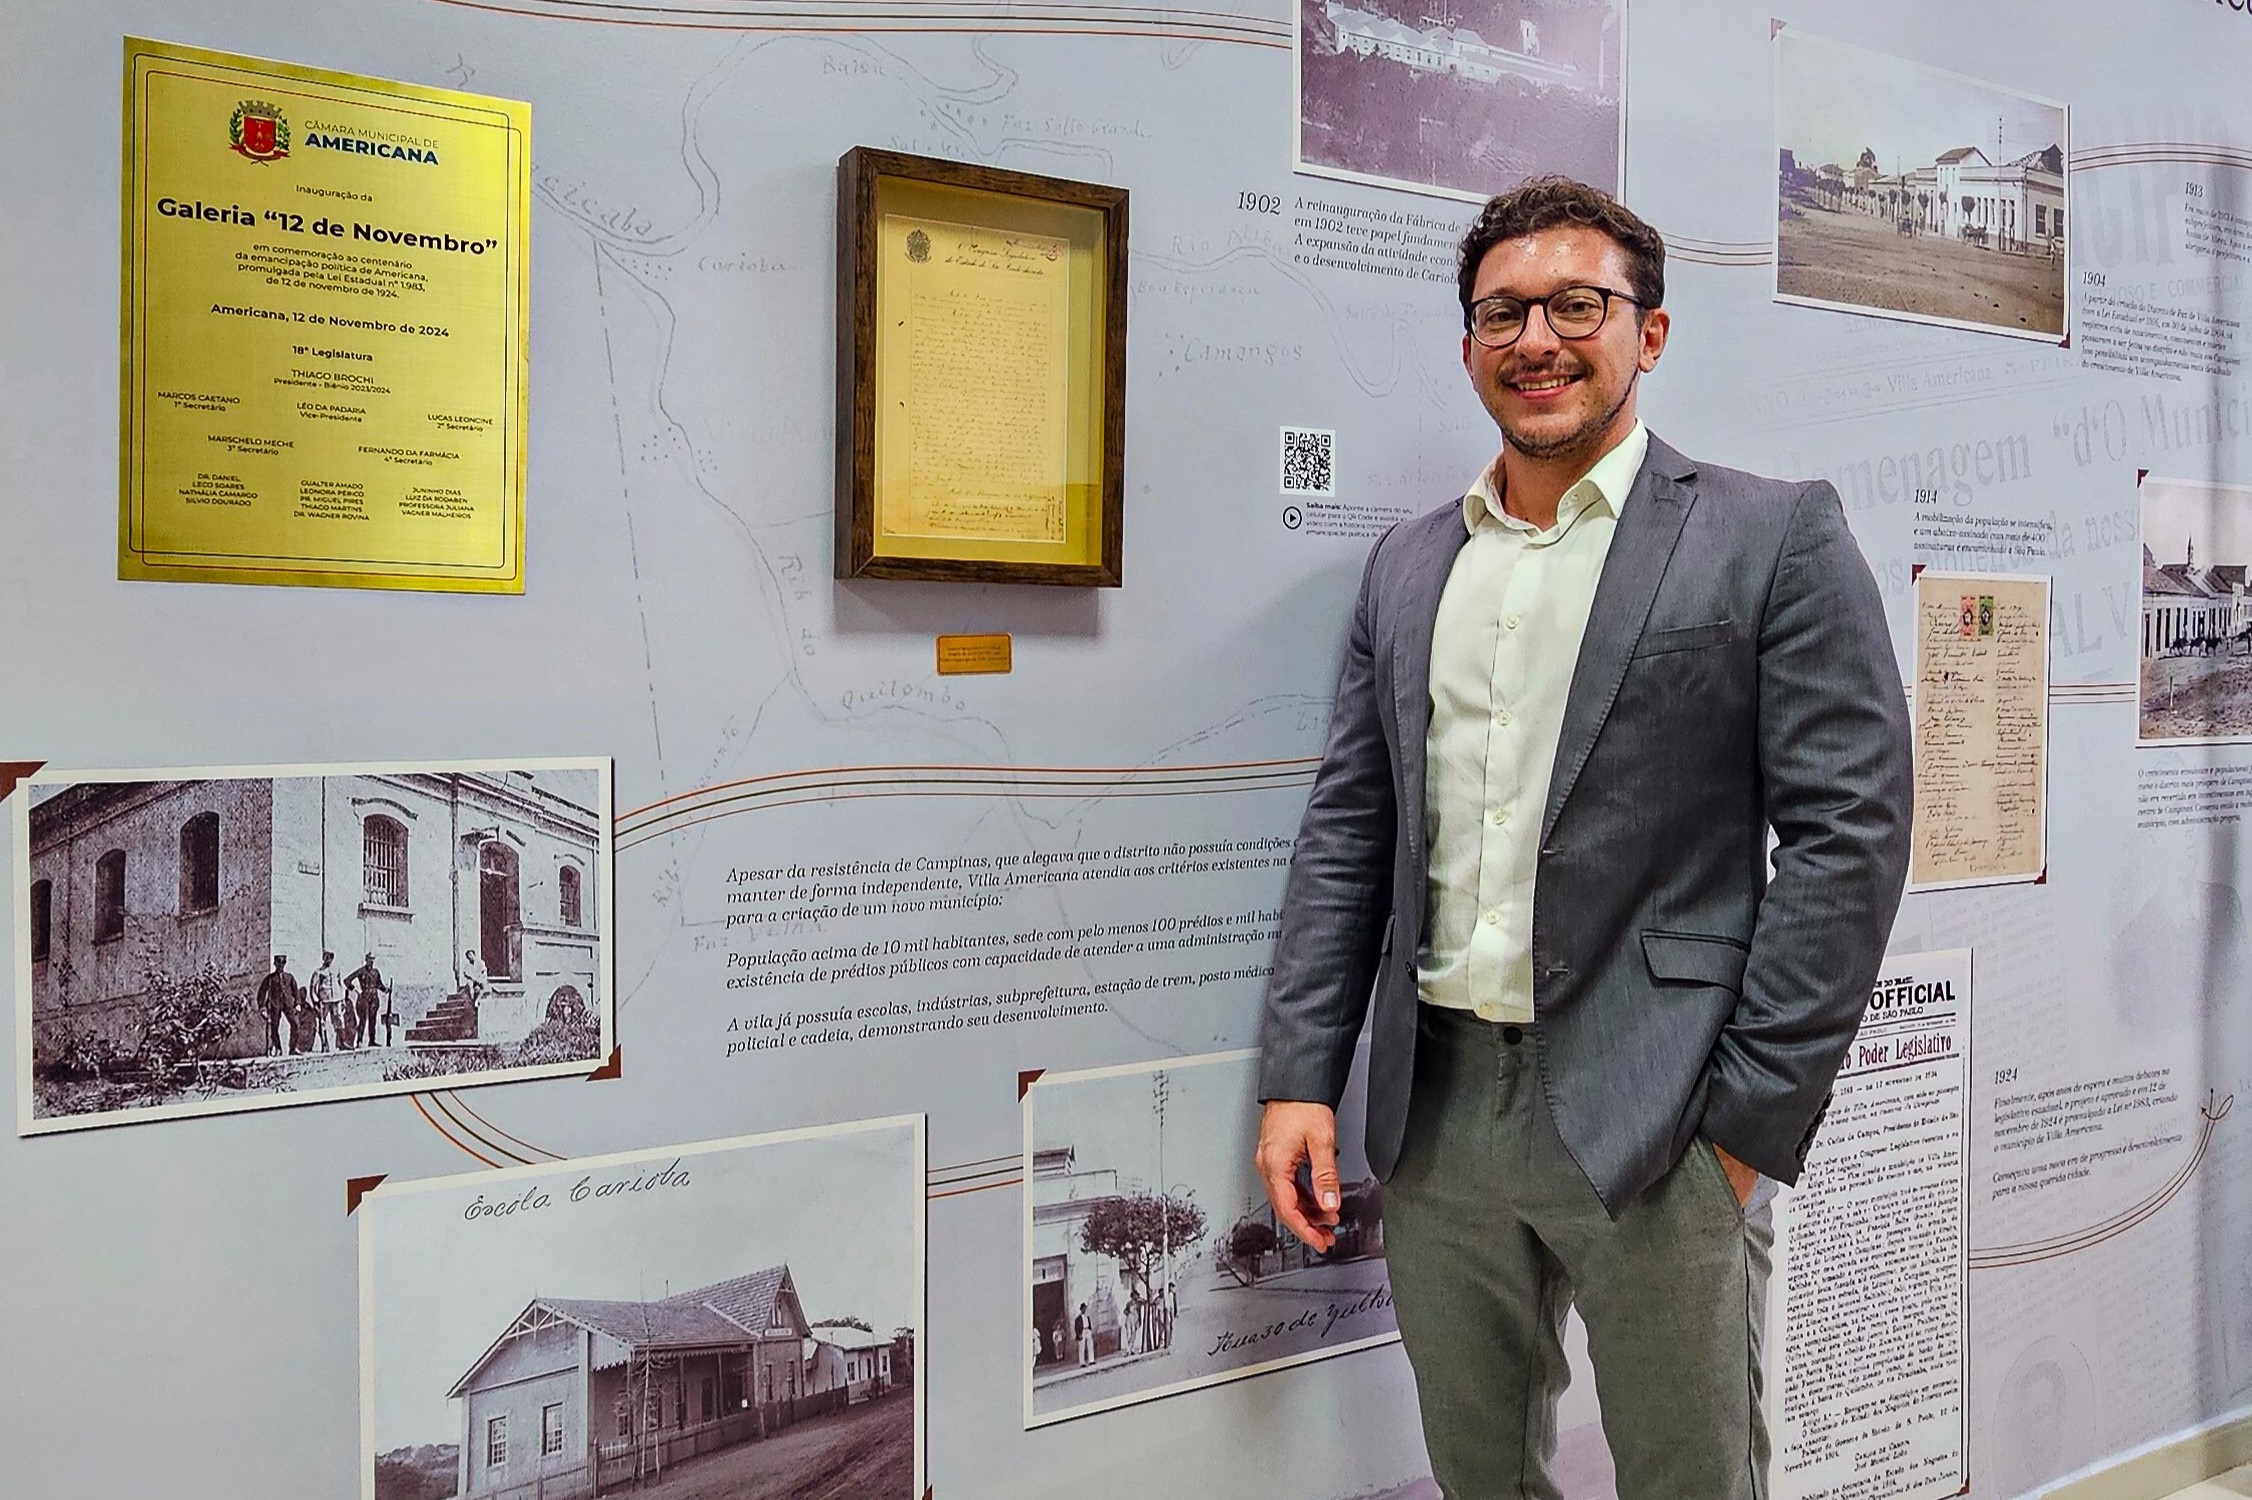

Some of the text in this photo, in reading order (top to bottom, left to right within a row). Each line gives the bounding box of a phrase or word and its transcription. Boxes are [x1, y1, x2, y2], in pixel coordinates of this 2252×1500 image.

[304, 120, 439, 149] CÂMARA MUNICIPAL DE
[304, 133, 438, 165] AMERICANA
[296, 184, 372, 202] Inauguração da
[1238, 191, 1280, 215] 1902
[157, 198, 255, 226] Galeria
[312, 217, 345, 237] de
[1294, 196, 1460, 232] A reinauguração da Fábrica de
[1294, 217, 1402, 245] em 1902 teve papel
[1294, 232, 1303, 245] A
[1306, 238, 1359, 253] expansão
[1360, 242, 1374, 256] da
[1377, 247, 1427, 262] atividade
[252, 244, 412, 269] em comemoração ao centenário
[1294, 252, 1456, 284] e o desenvolvimento de Cariob
[2083, 271, 2106, 288] 1904
[210, 303, 449, 337] Americana, 12 de Novembro de 2024
[311, 347, 373, 361] Legislatura
[291, 368, 374, 384] THIAGO BROCHI
[1914, 488, 1938, 504] 1914
[726, 868, 783, 886] Apesar
[786, 863, 805, 879] da
[810, 860, 890, 877] resistência
[894, 857, 911, 873] de
[916, 855, 991, 873] Campinas,
[995, 855, 1019, 870] que
[1022, 850, 1073, 867] alegava
[1077, 850, 1100, 865] que
[1103, 850, 1110, 860] o
[1113, 845, 1160, 859] distrito
[1163, 842, 1186, 856] não
[1187, 839, 1233, 858] possuía
[1236, 836, 1290, 852] condições
[727, 889, 785, 904] manter
[789, 884, 810, 901] de
[809, 882, 856, 903] forma
[862, 876, 962, 897] independente,
[968, 872, 999, 887] Villa
[1004, 870, 1078, 885] Americana
[1082, 864, 1130, 880] atendia
[1133, 866, 1154, 877] aos
[1157, 859, 1209, 875] critérios
[1211, 858, 1270, 871] existentes
[1272, 857, 1286, 866] na
[725, 893, 1003, 929] para a criação de um novo município:
[727, 948, 806, 970] População
[811, 946, 857, 961] acima
[861, 941, 879, 957] de
[883, 939, 900, 955] 10
[904, 937, 928, 953] mil
[932, 934, 1009, 950] habitantes,
[1013, 928, 1043, 944] sede
[1046, 929, 1074, 941] com
[1076, 923, 1104, 942] pelo
[1107, 923, 1148, 935] menos
[1152, 917, 1176, 932] 100
[1178, 914, 1223, 933] prédios
[1226, 916, 1232, 925] e
[1235, 910, 1255, 924] mil
[726, 969, 804, 989] existência
[809, 966, 827, 982] de
[830, 962, 886, 983] prédios
[888, 957, 948, 978] públicos
[952, 956, 980, 969] com
[984, 946, 1061, 968] capacidade
[1064, 944, 1080, 959] de
[1083, 940, 1133, 957] atender
[1135, 942, 1143, 952] a
[1147, 939, 1175, 951] uma
[1178, 929, 1264, 948] administração
[726, 965, 1274, 1032] A vila já possuía escolas, indústrias, subprefeitura, estação de trem, posto médico
[1869, 980, 1956, 1011] OFFICIAL
[726, 1002, 1108, 1057] policial e cadeia, demonstrando seu desenvolvimento.
[1858, 1032, 1952, 1068] Poder Legislativo
[1994, 1067, 2018, 1085] 1924
